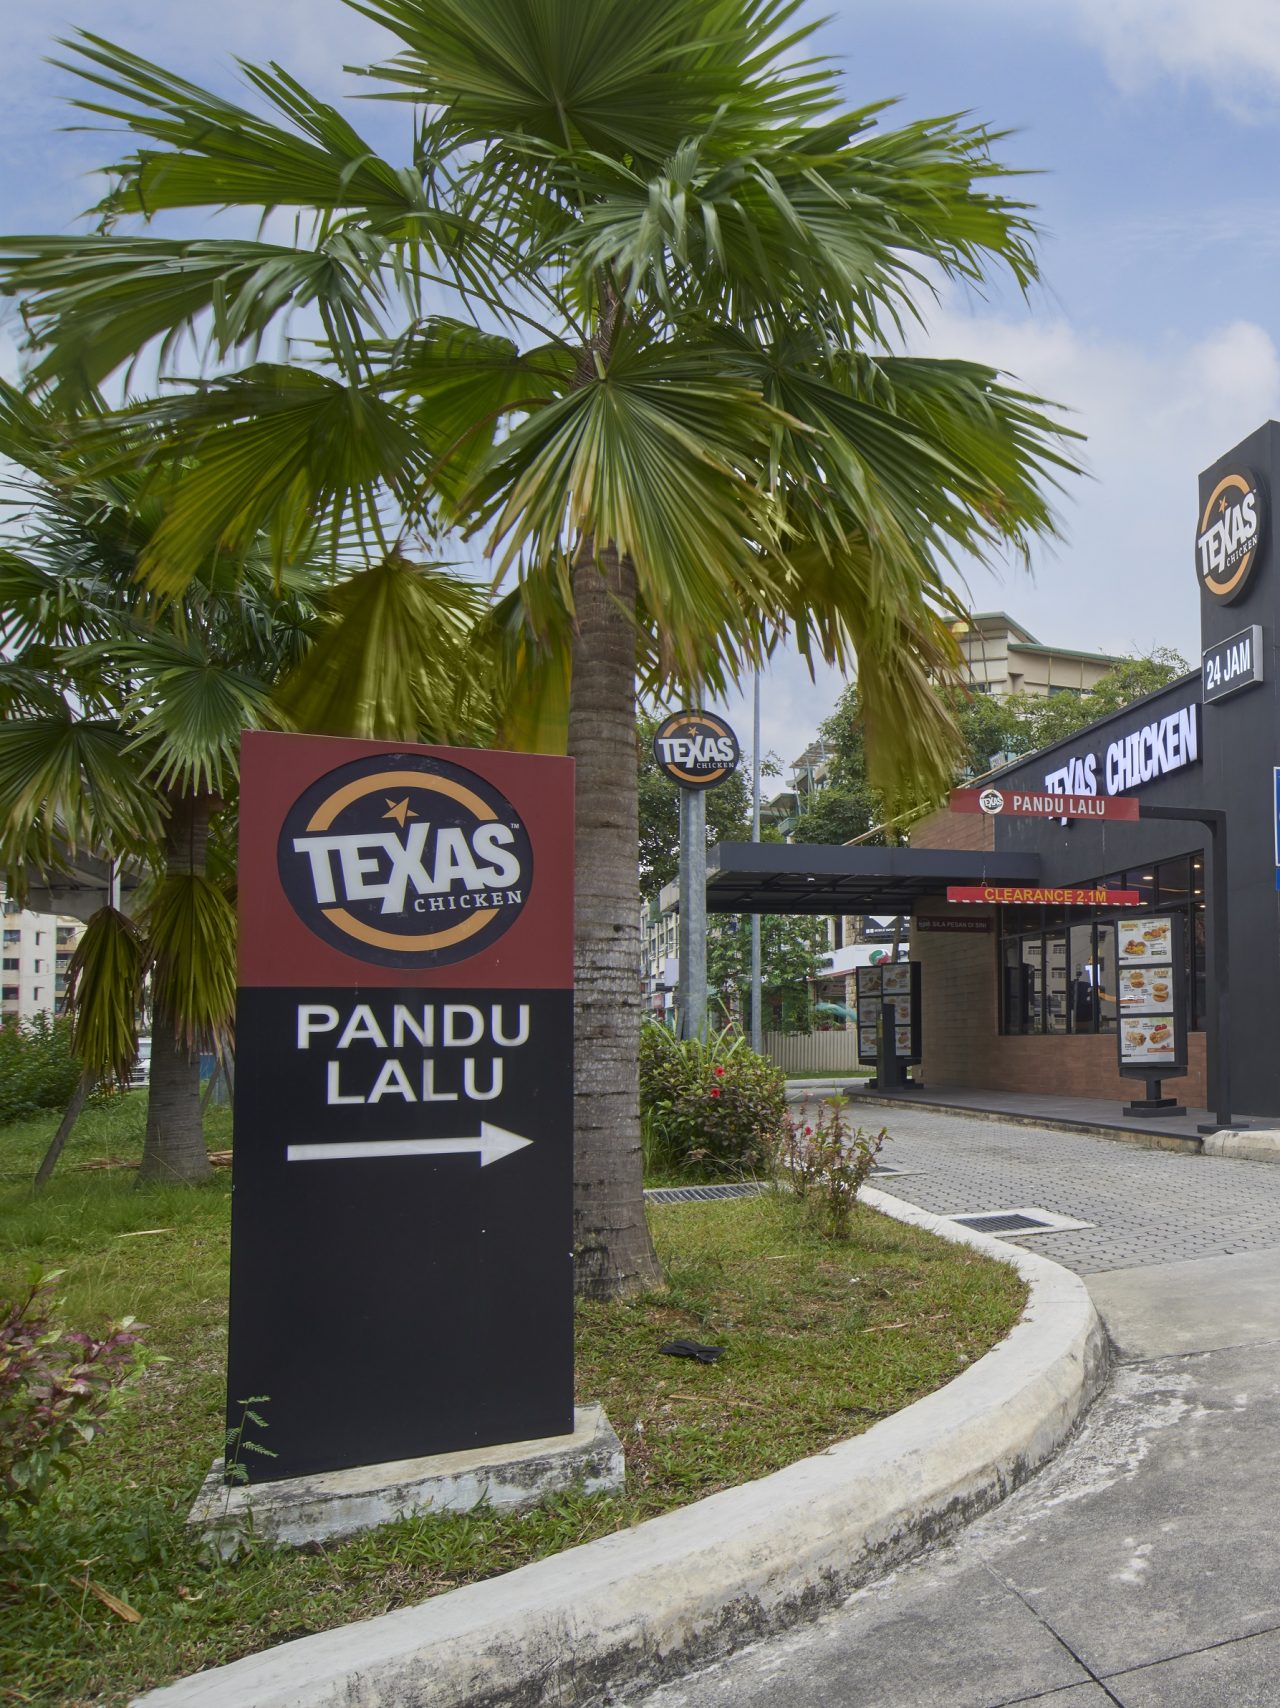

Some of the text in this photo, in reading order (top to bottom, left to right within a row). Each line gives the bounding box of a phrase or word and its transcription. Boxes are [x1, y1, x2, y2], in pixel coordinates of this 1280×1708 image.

[1198, 492, 1257, 576] TEXAS
[1226, 534, 1258, 567] CHICKEN
[1206, 638, 1250, 690] 24 JAM
[658, 735, 735, 768] TEXAS
[1105, 704, 1198, 796] CHICKEN
[1013, 796, 1105, 815] PANDU LALU
[293, 822, 521, 914] TEXAS
[414, 890, 523, 912] CHICKEN
[984, 888, 1107, 903] CLEARANCE 2.1M
[296, 1004, 530, 1050] PANDU
[326, 1057, 504, 1105] LALU
